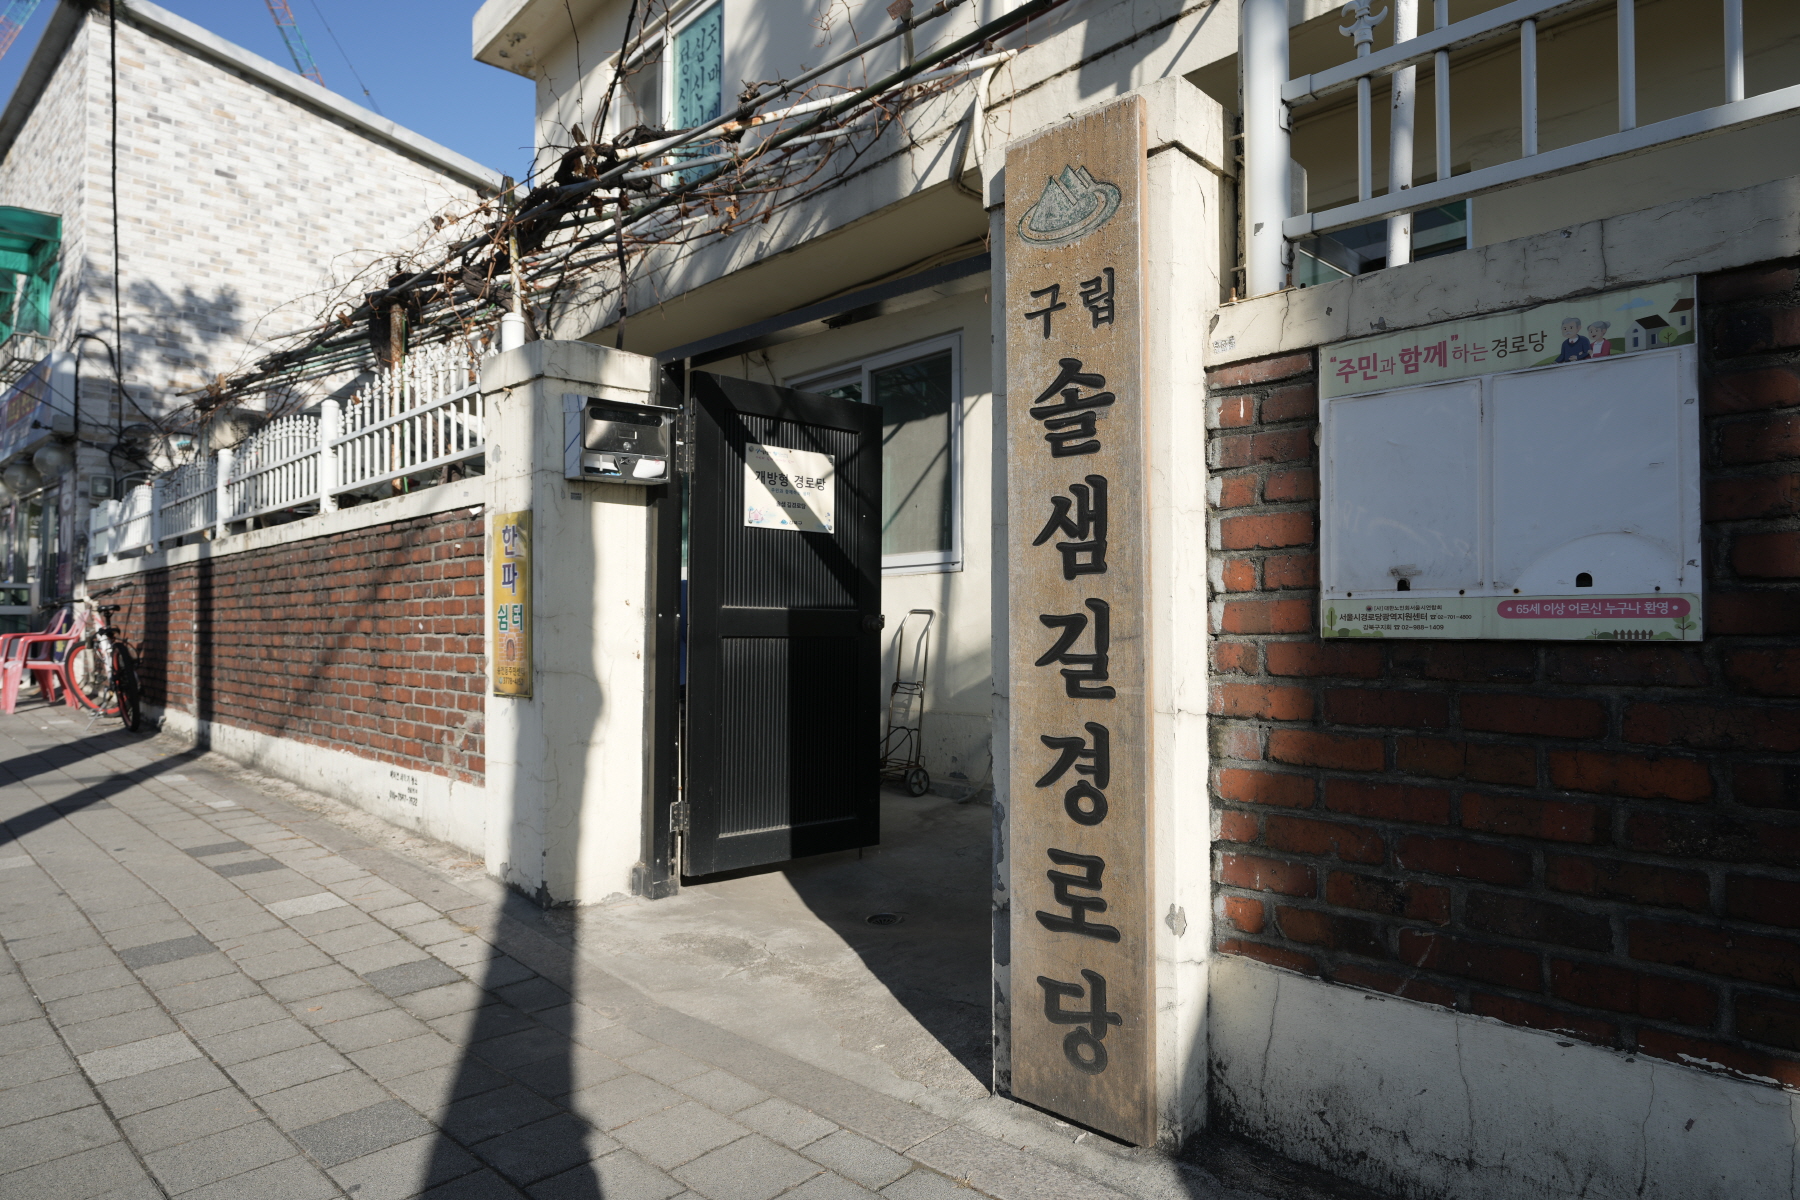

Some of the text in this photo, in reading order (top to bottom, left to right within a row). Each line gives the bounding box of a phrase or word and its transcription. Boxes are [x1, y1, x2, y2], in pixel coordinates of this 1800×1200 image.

[1024, 267, 1114, 339] 구립
[1491, 330, 1548, 359] 경로당
[755, 470, 826, 491] 개방형 경로당
[497, 603, 524, 633] 쉼터
[1516, 601, 1669, 616] 65세 이상 어르신 누구나 환영
